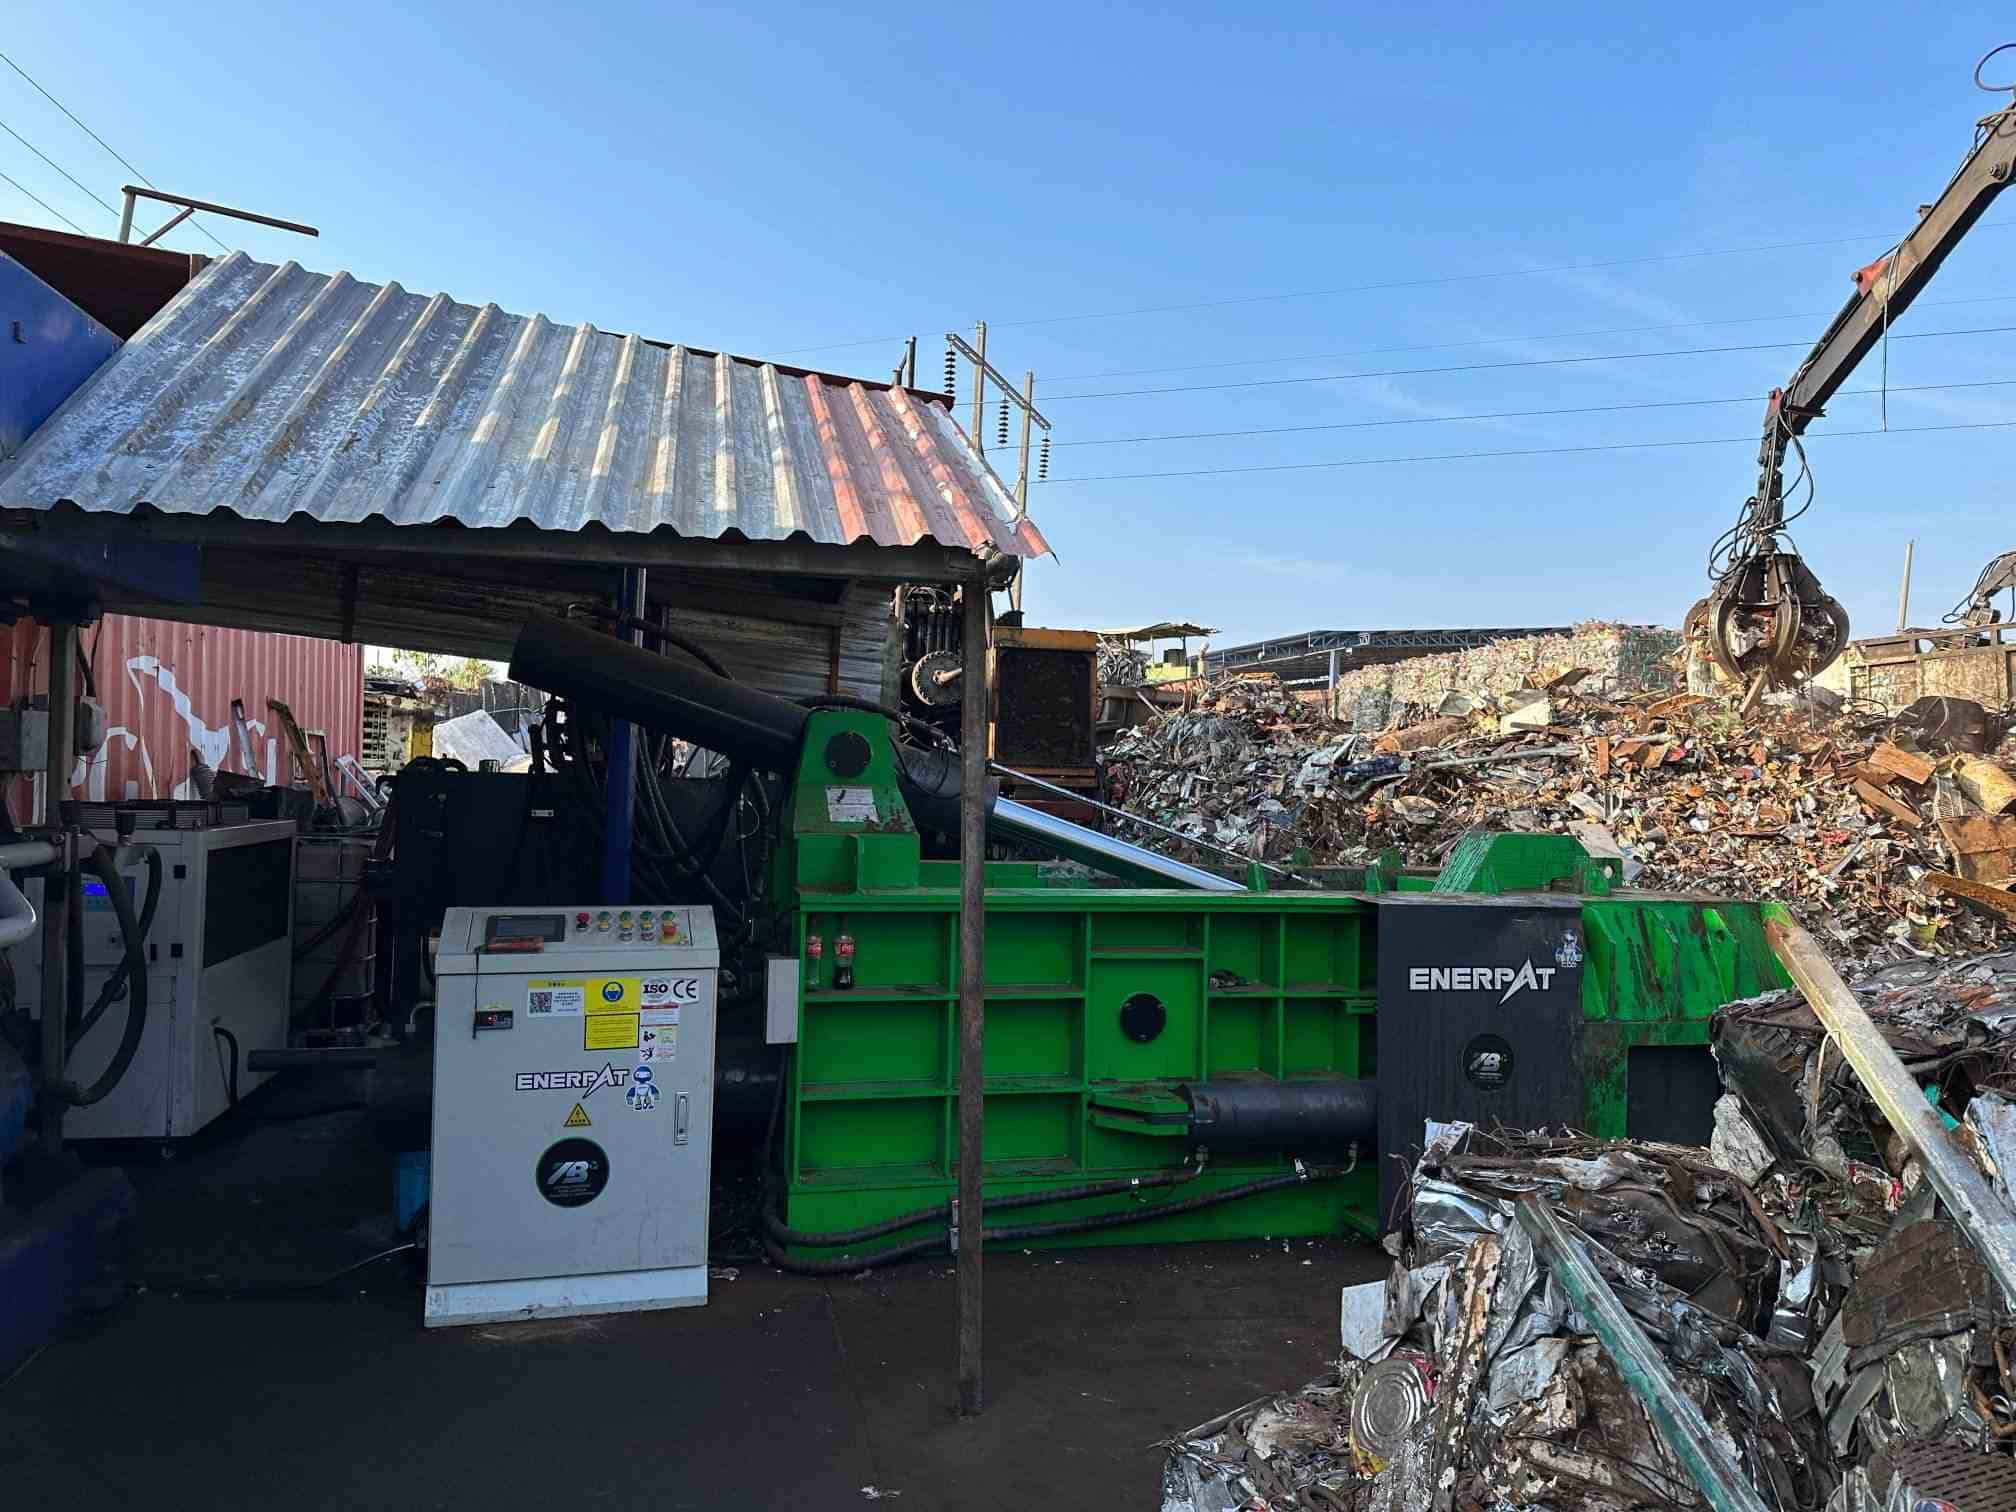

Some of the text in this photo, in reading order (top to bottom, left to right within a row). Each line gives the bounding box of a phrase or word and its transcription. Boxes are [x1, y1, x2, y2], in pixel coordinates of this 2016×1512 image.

[643, 983, 669, 994] ISO
[673, 980, 697, 998] CE
[1409, 955, 1556, 1005] ENERPAT
[515, 1063, 629, 1099] ENERPAT
